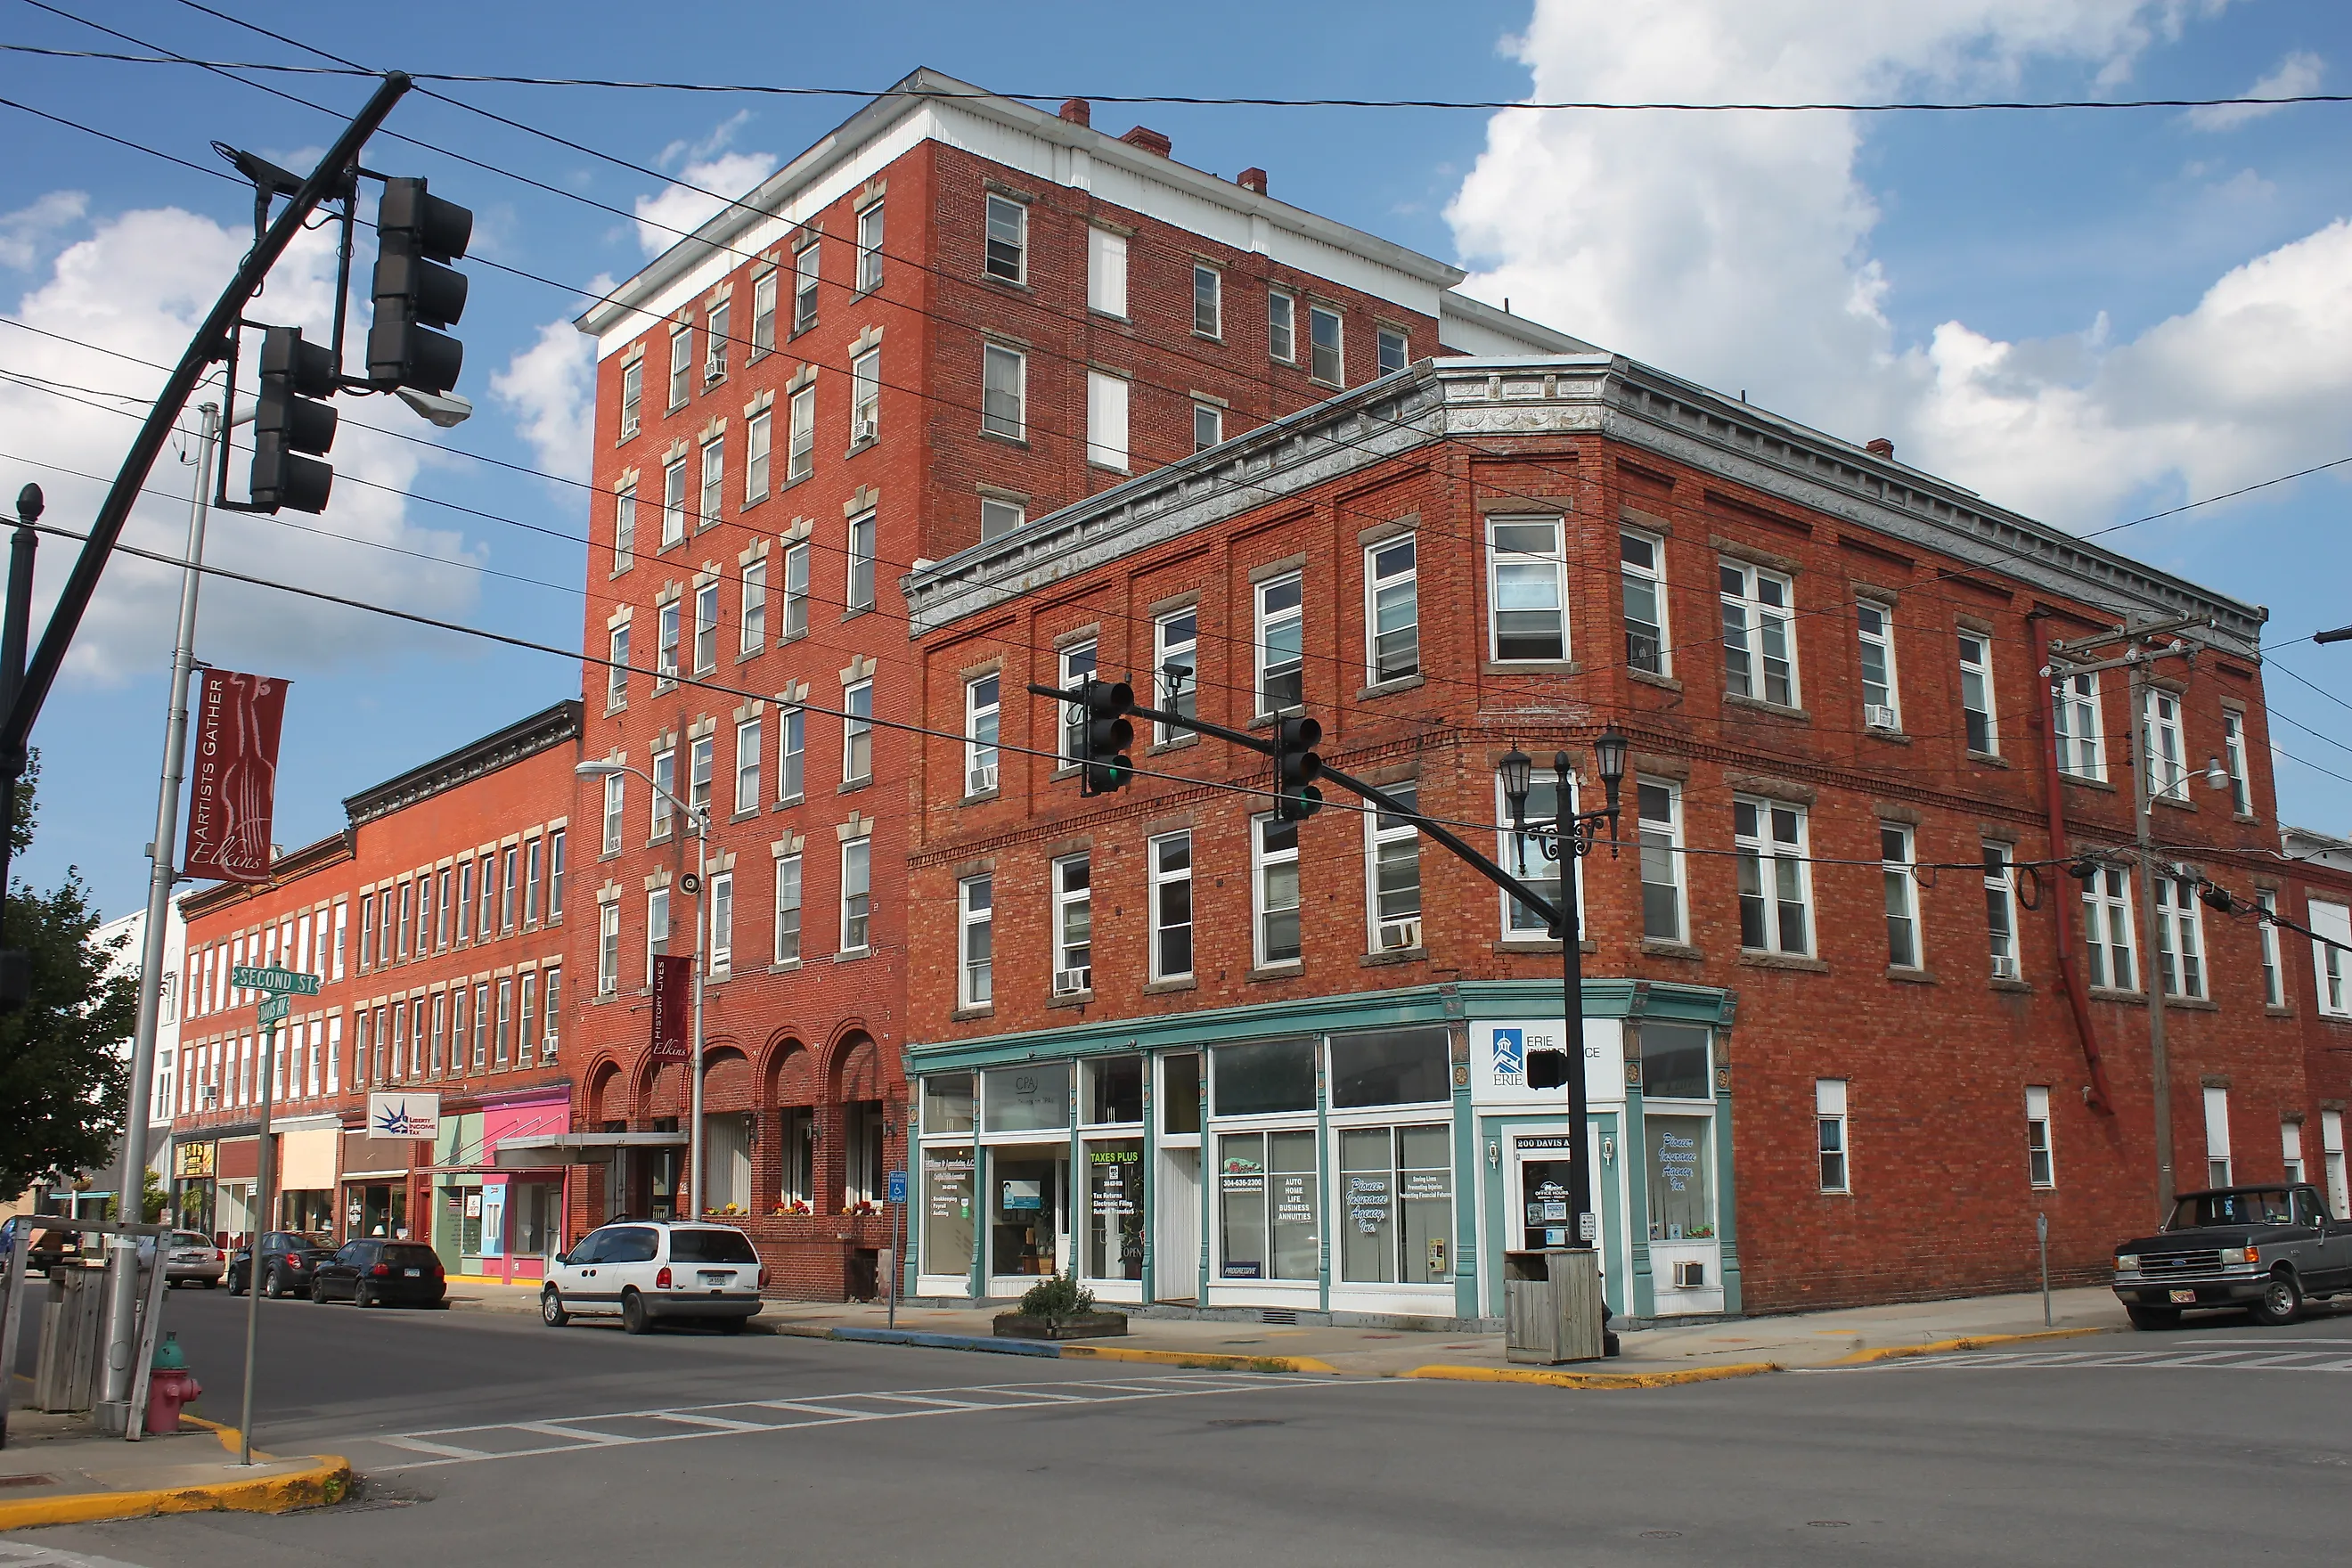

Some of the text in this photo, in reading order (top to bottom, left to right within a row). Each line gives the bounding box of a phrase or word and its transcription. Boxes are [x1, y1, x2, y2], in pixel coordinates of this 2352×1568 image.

[194, 679, 224, 841] ARTISTS GATHER
[190, 835, 263, 870] Elkins
[240, 968, 291, 990] SECOND
[654, 961, 665, 1040] HISTORY LIVES
[653, 1038, 687, 1056] Elkins
[1526, 1035, 1554, 1047] ERIE
[1016, 1076, 1035, 1090] CPA
[1493, 1074, 1523, 1086] ERIE
[1517, 1139, 1535, 1147] 200
[1536, 1139, 1563, 1147] DAVIS
[1662, 1131, 1694, 1147] Pioneer
[1090, 1151, 1139, 1163] TAXES PLUS
[1658, 1147, 1696, 1162] Insurance
[1222, 1178, 1262, 1187] 304-636-2300
[1285, 1178, 1302, 1186] AUTO
[1352, 1177, 1384, 1192] Pioneer
[1118, 1200, 1133, 1208] Filing
[1287, 1195, 1301, 1203] LIFE
[1346, 1191, 1388, 1205] Insurance
[1278, 1204, 1310, 1212] BUSINESS
[1278, 1213, 1311, 1221] ANNUITIES
[1123, 1247, 1142, 1258] OPEN
[1225, 1266, 1256, 1275] PROGRESSIVE
